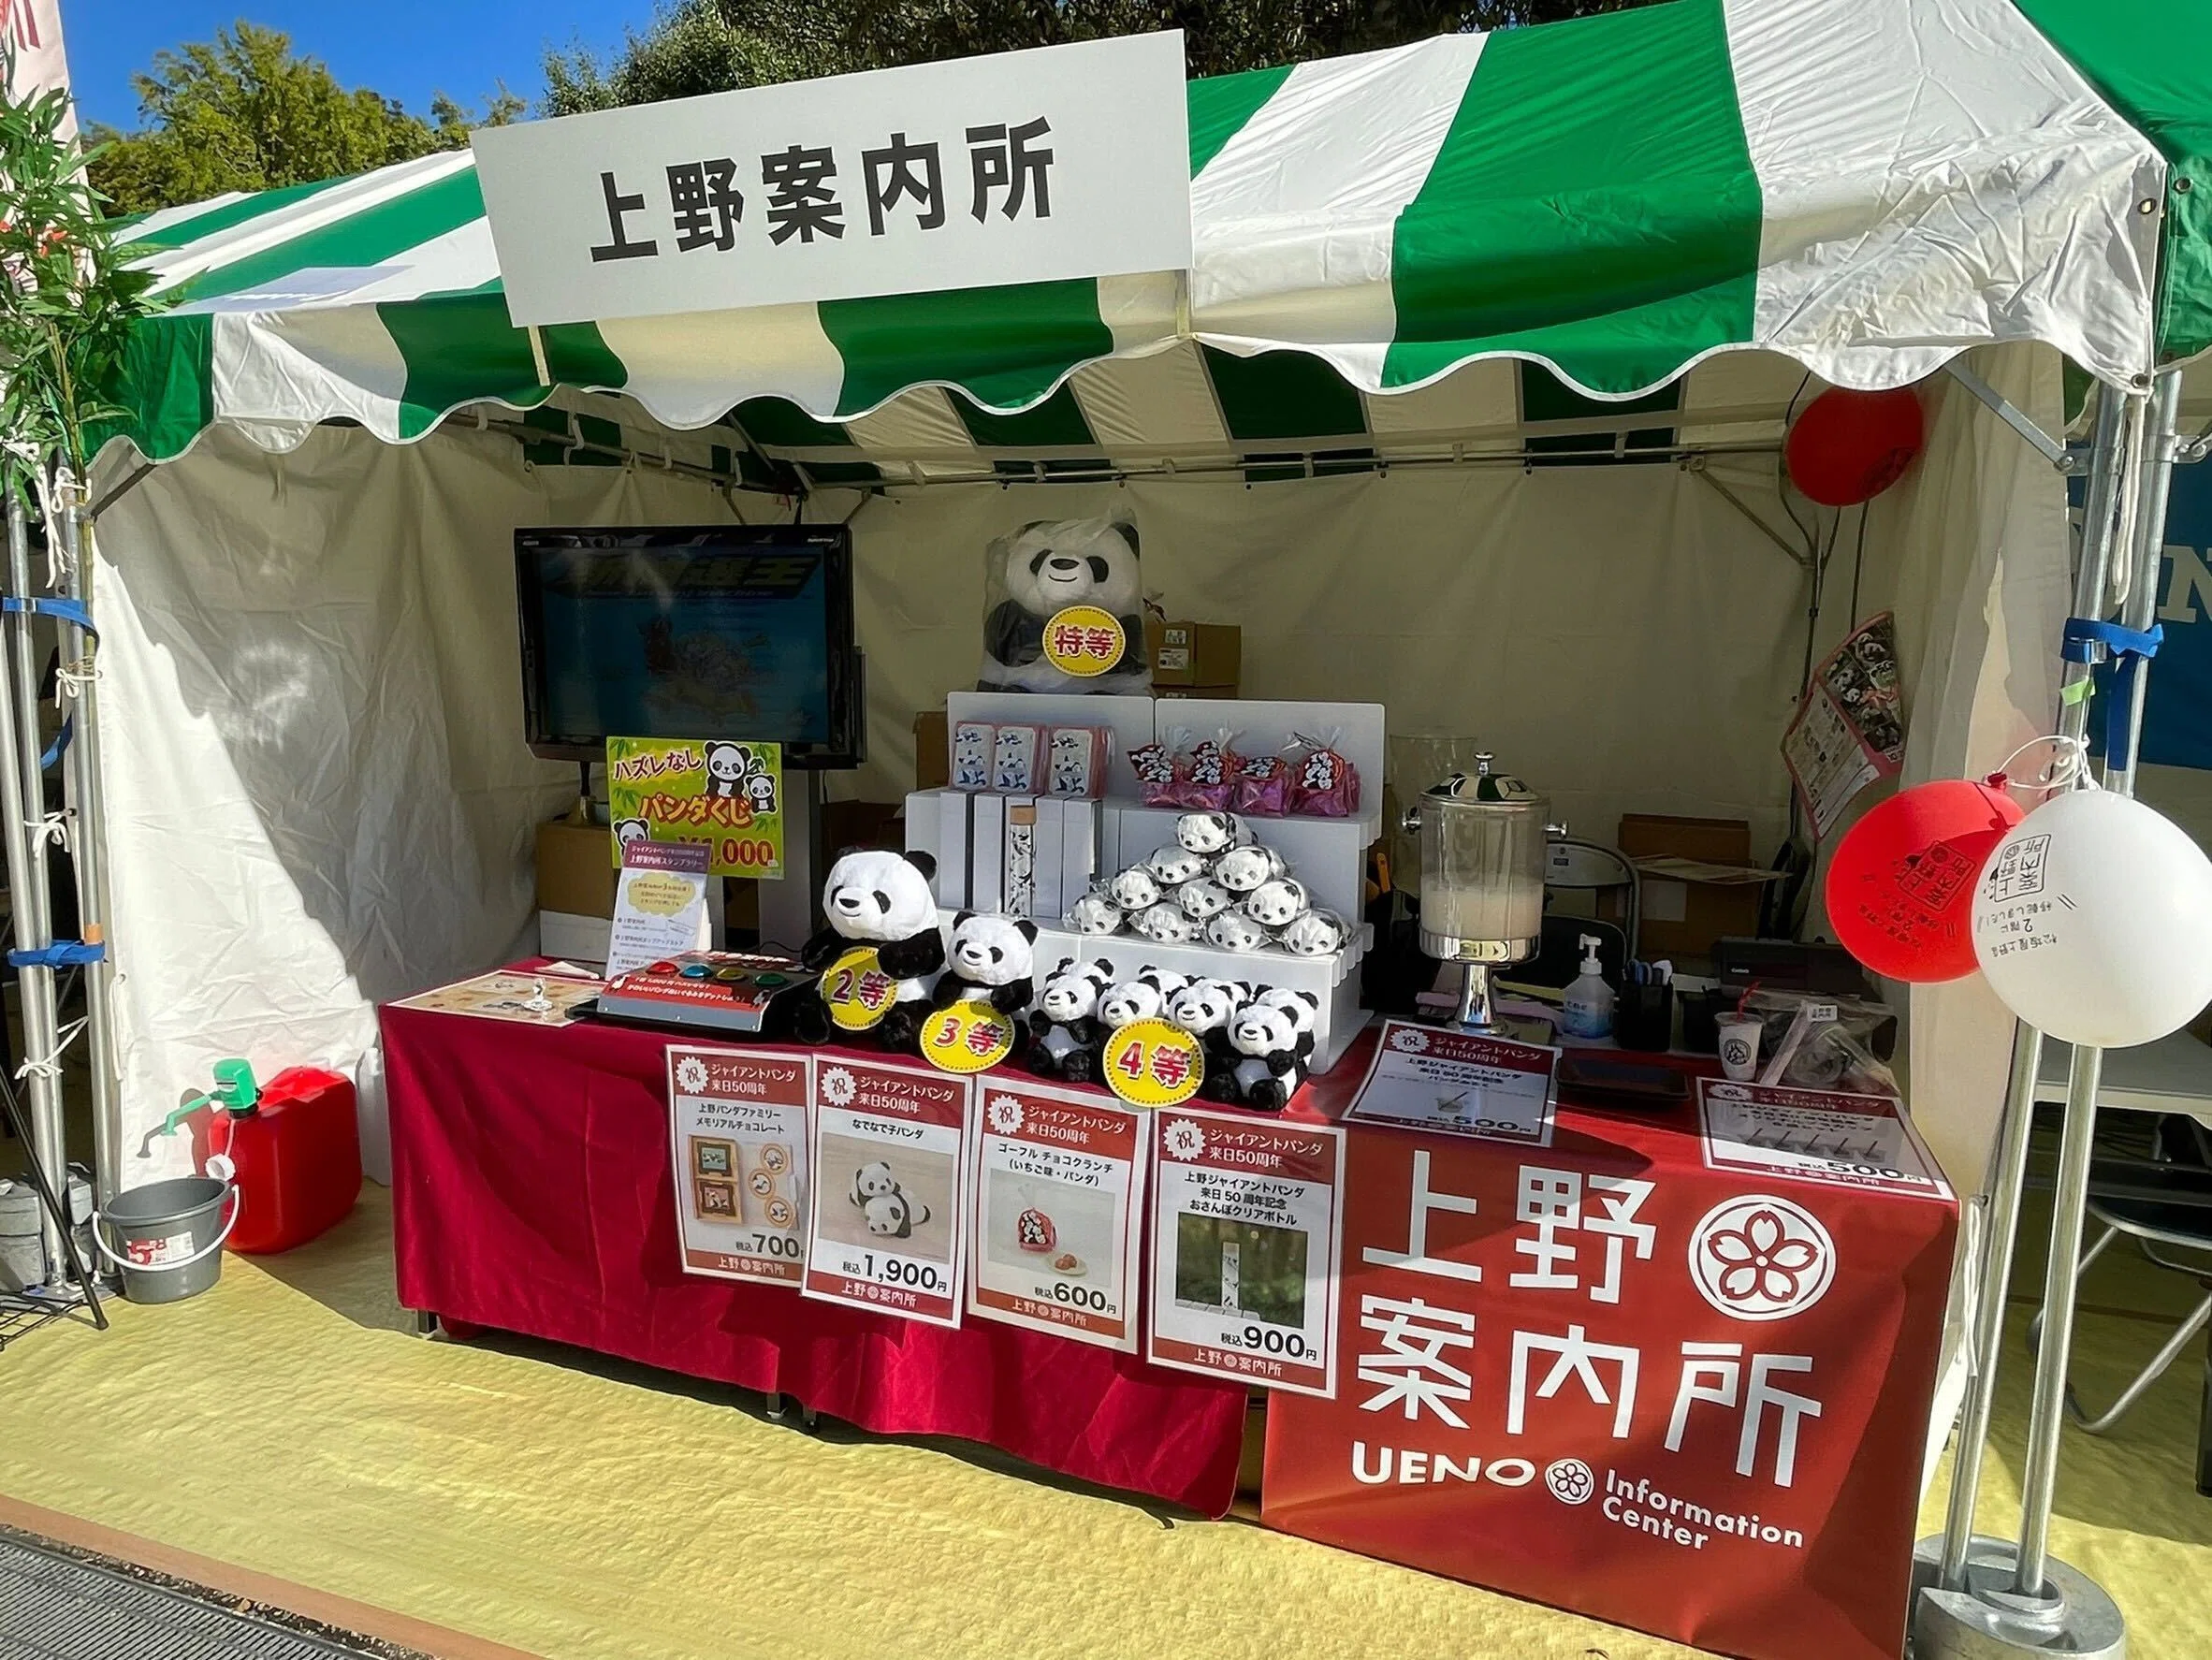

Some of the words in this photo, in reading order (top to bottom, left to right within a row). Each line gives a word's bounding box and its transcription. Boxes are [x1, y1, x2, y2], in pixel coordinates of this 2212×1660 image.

[590, 115, 1054, 263] 上野案内所
[1054, 625, 1116, 661] 特等
[613, 749, 705, 780] ハズレなし
[638, 793, 753, 827] パンダくじ
[835, 970, 887, 1009] 2等
[935, 1016, 1001, 1055] 3等
[710, 1063, 796, 1081] ジャイアントパンダ
[1116, 1041, 1192, 1088] 4等
[711, 1080, 767, 1095] 来日50周年
[831, 1077, 848, 1096] 祝
[859, 1076, 954, 1102] ジャイアントパンダ
[699, 1102, 781, 1118] 上野パンダファミリー
[858, 1091, 921, 1114] 来日50周年
[997, 1105, 1014, 1124] 祝
[696, 1117, 784, 1134] メモリアルチョコレート
[852, 1118, 924, 1140] なでなで子パンダ
[1026, 1124, 1090, 1145] 来日50周年
[1027, 1105, 1126, 1135] ジャイアントパンダ
[1175, 1130, 1195, 1150] 祝
[1209, 1129, 1324, 1158] ジャイアントパンダ
[997, 1143, 1038, 1159] ゴーフル
[1042, 1150, 1113, 1173] チョコクランチ
[1208, 1147, 1283, 1169] 来日50周年
[1184, 1172, 1306, 1200] 上野ジャイアントパンダ
[1189, 1200, 1298, 1227] おさんぽクリアボトル
[1361, 1149, 1656, 1304] 上野
[1356, 1293, 1823, 1489] 案内所
[1351, 1440, 1536, 1487] UENO
[1606, 1468, 1804, 1549] Information
[1602, 1497, 1710, 1551] Center
